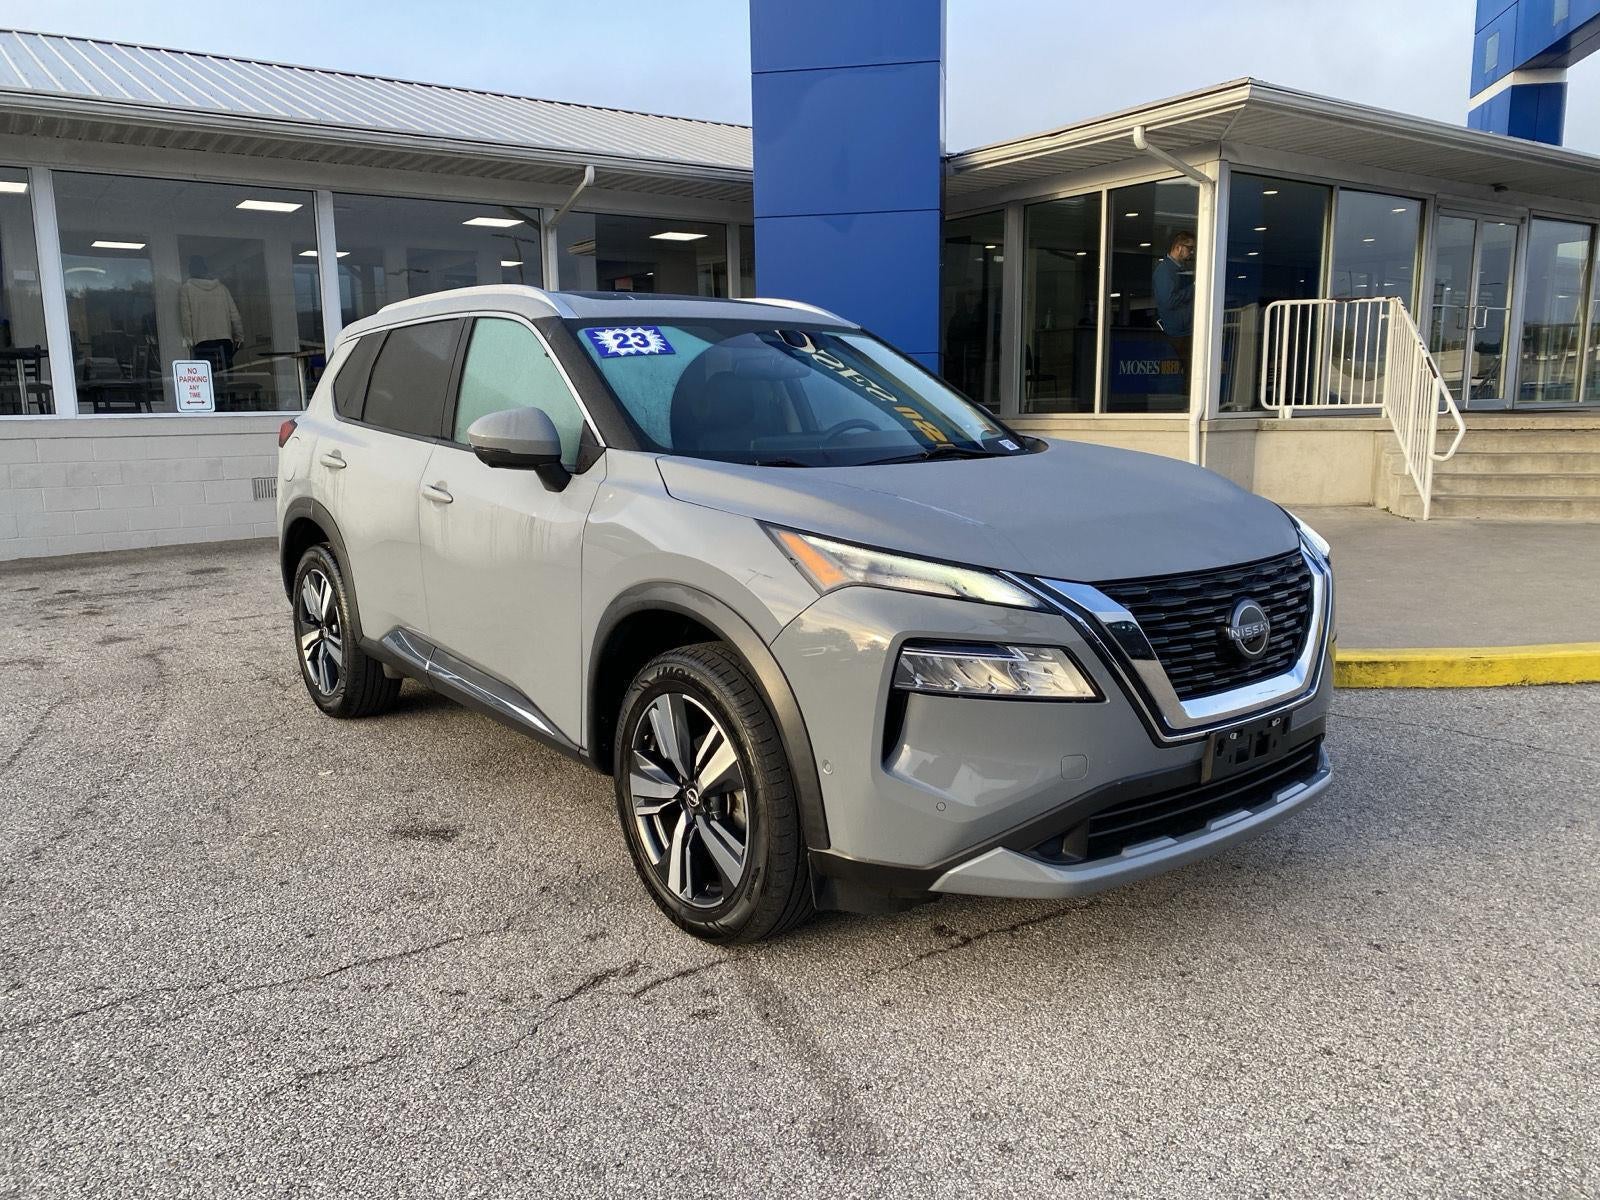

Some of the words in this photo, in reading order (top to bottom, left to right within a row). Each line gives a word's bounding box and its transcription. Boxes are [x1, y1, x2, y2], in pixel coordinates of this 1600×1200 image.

[612, 332, 651, 349] 23
[187, 367, 198, 375] NO
[1119, 359, 1160, 375] MOSES
[179, 375, 208, 383] PARKING
[1231, 622, 1270, 638] NISSAN
